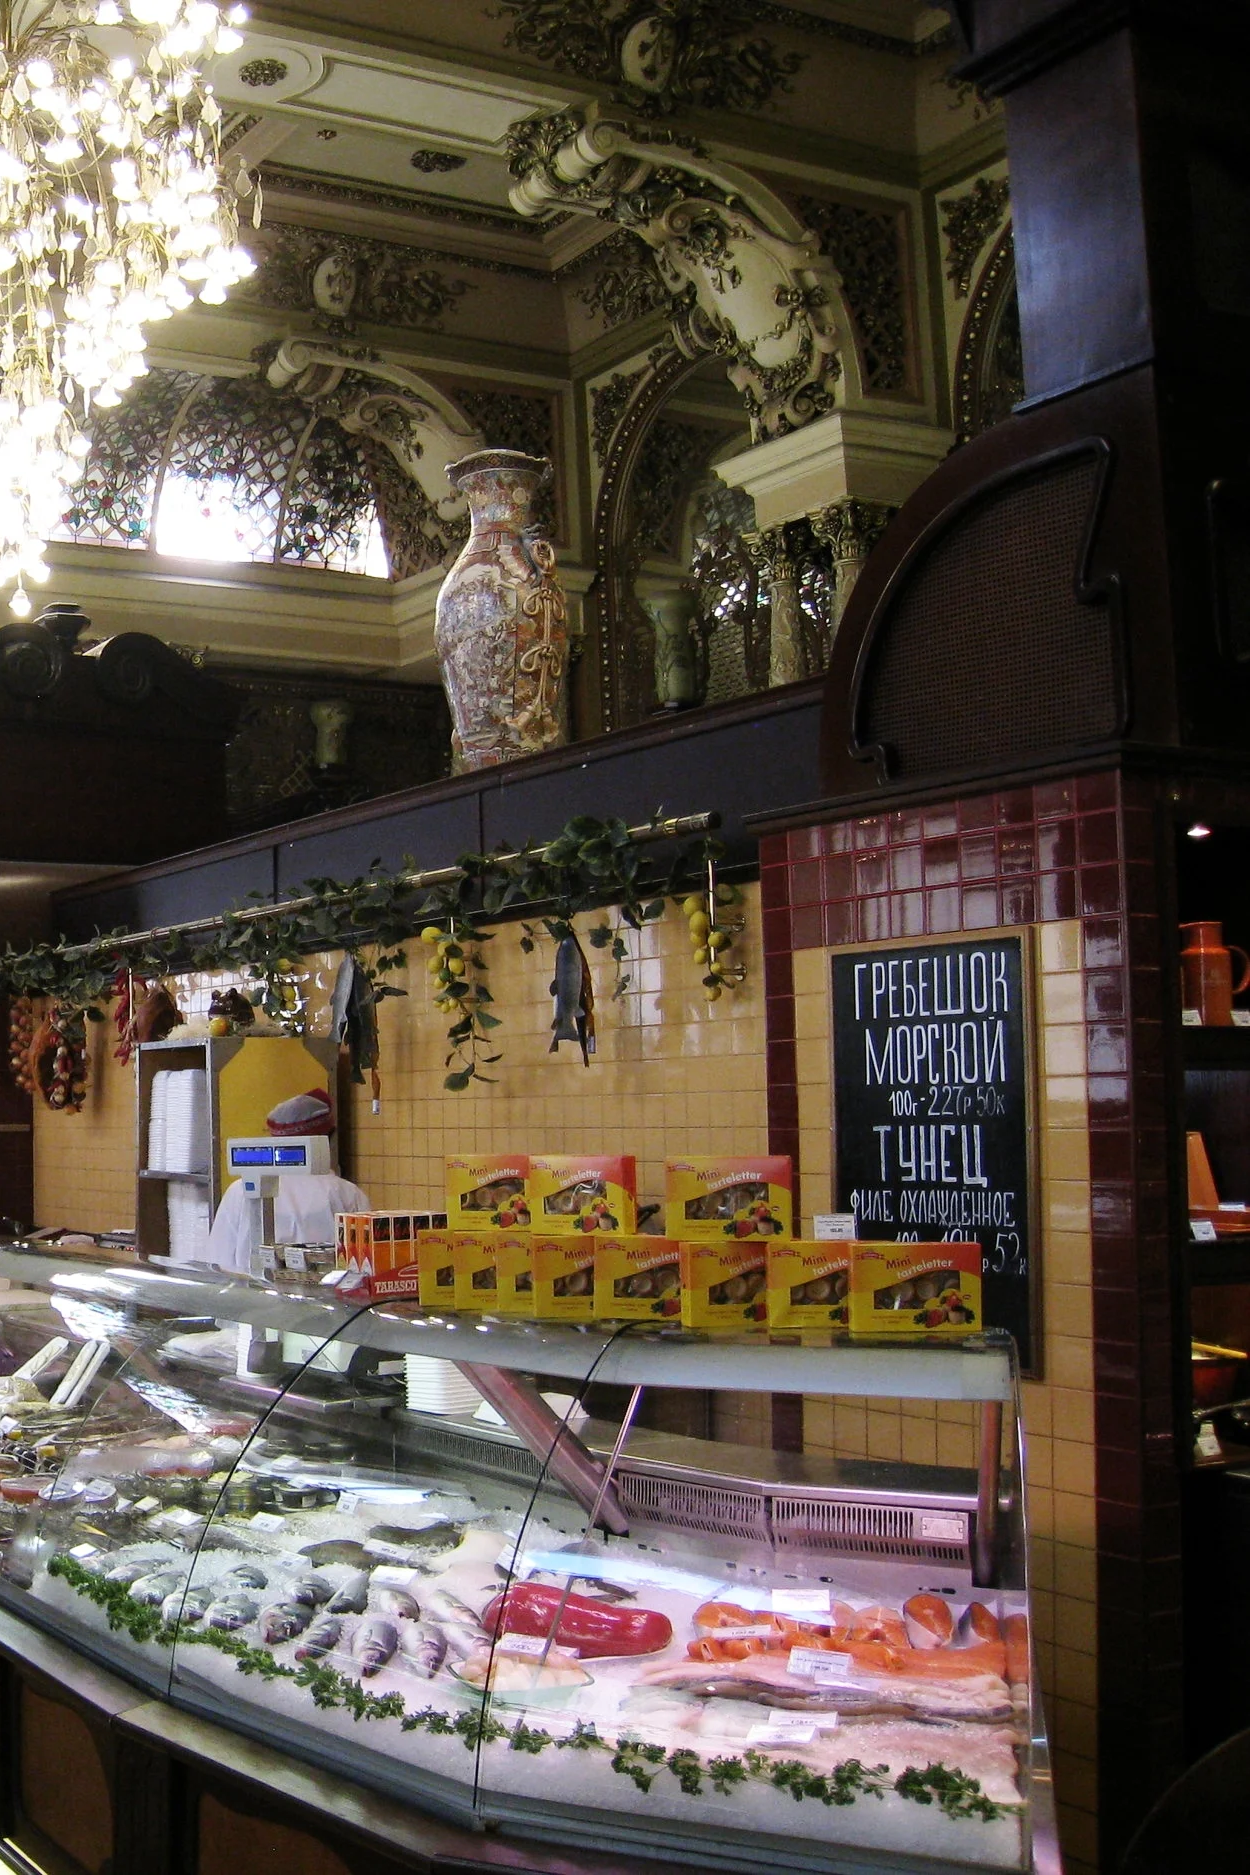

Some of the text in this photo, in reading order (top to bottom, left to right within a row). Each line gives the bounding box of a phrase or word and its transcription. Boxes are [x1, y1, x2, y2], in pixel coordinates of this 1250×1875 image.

[854, 951, 1008, 1020] ГРЕБЕШОК
[865, 1016, 1006, 1086] МОРСКОЙ
[696, 1168, 719, 1181] Mini
[872, 1124, 988, 1188] ТУНЕЦ
[850, 1188, 894, 1225] ФИЛЕ
[802, 1252, 827, 1267] Mini
[886, 1255, 910, 1270] Mini
